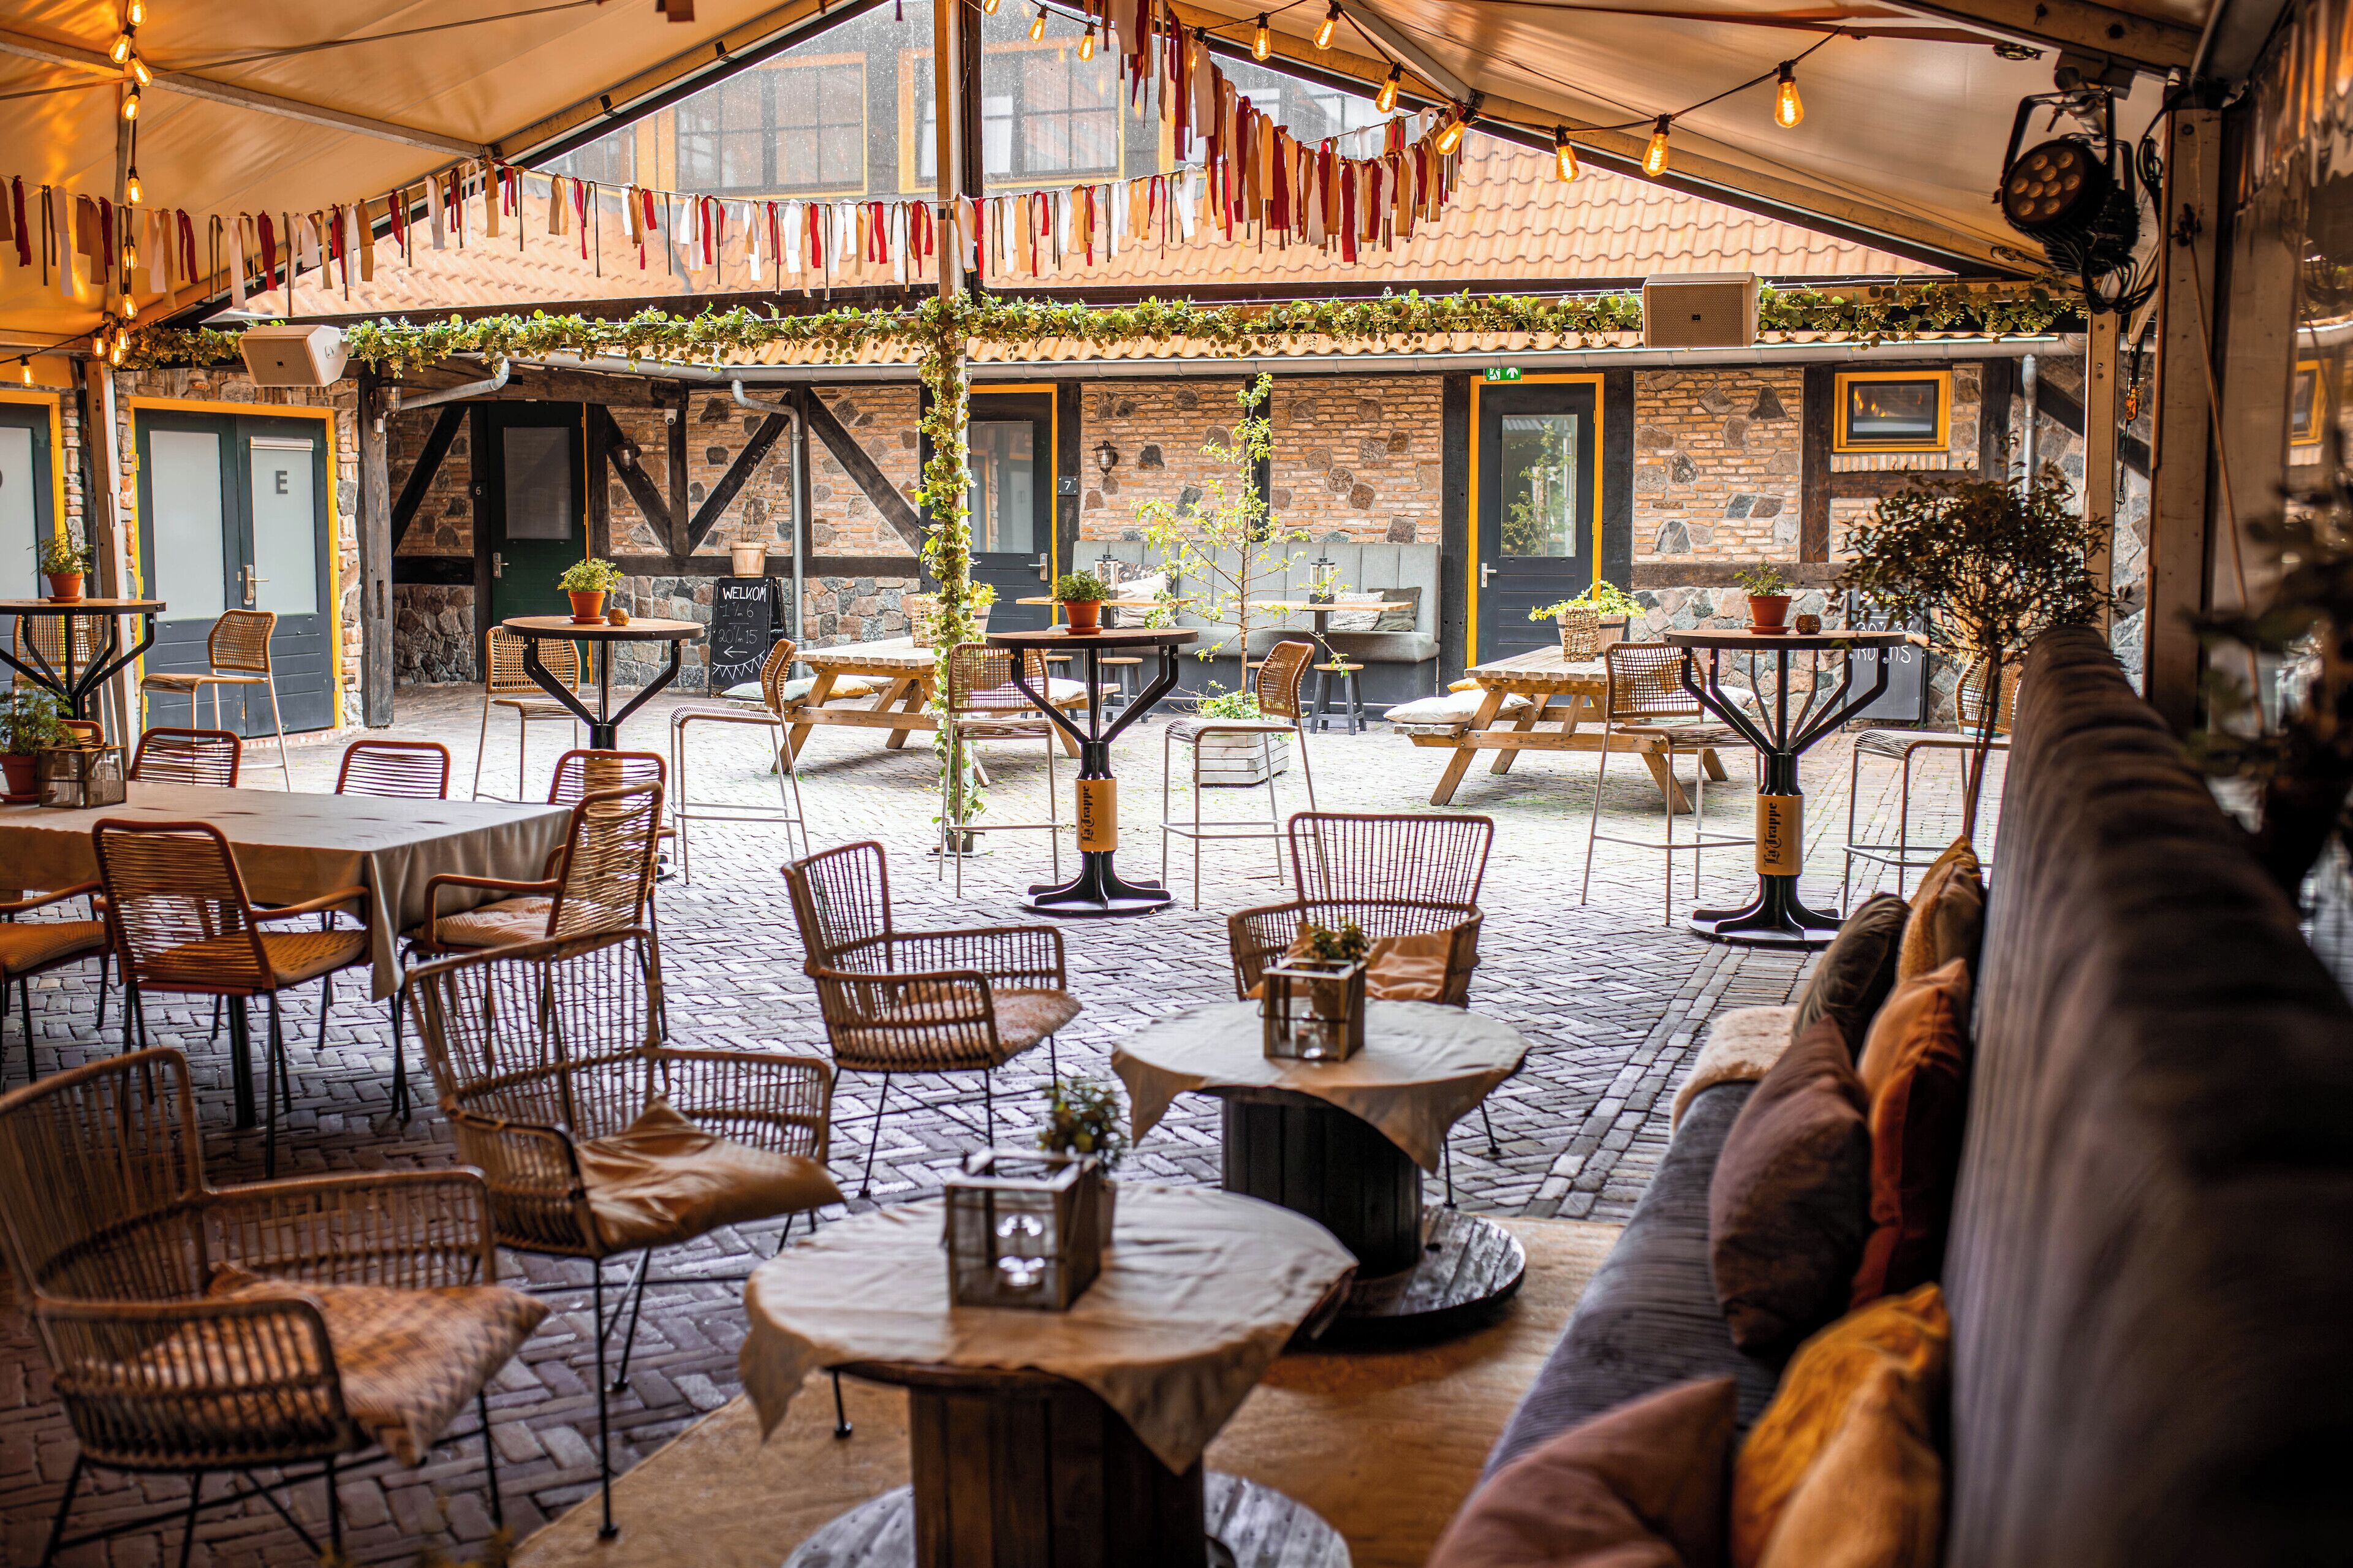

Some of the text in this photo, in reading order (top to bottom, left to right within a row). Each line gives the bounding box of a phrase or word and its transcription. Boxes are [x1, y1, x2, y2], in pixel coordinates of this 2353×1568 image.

[276, 470, 288, 494] E
[1064, 480, 1072, 490] 7
[476, 486, 481, 495] 6
[722, 586, 766, 602] WELKOM
[746, 602, 754, 618] 6
[718, 629, 733, 644] 20
[745, 629, 759, 644] 15
[1080, 786, 1096, 844] La Trappe
[1764, 802, 1784, 867] La Trappe
